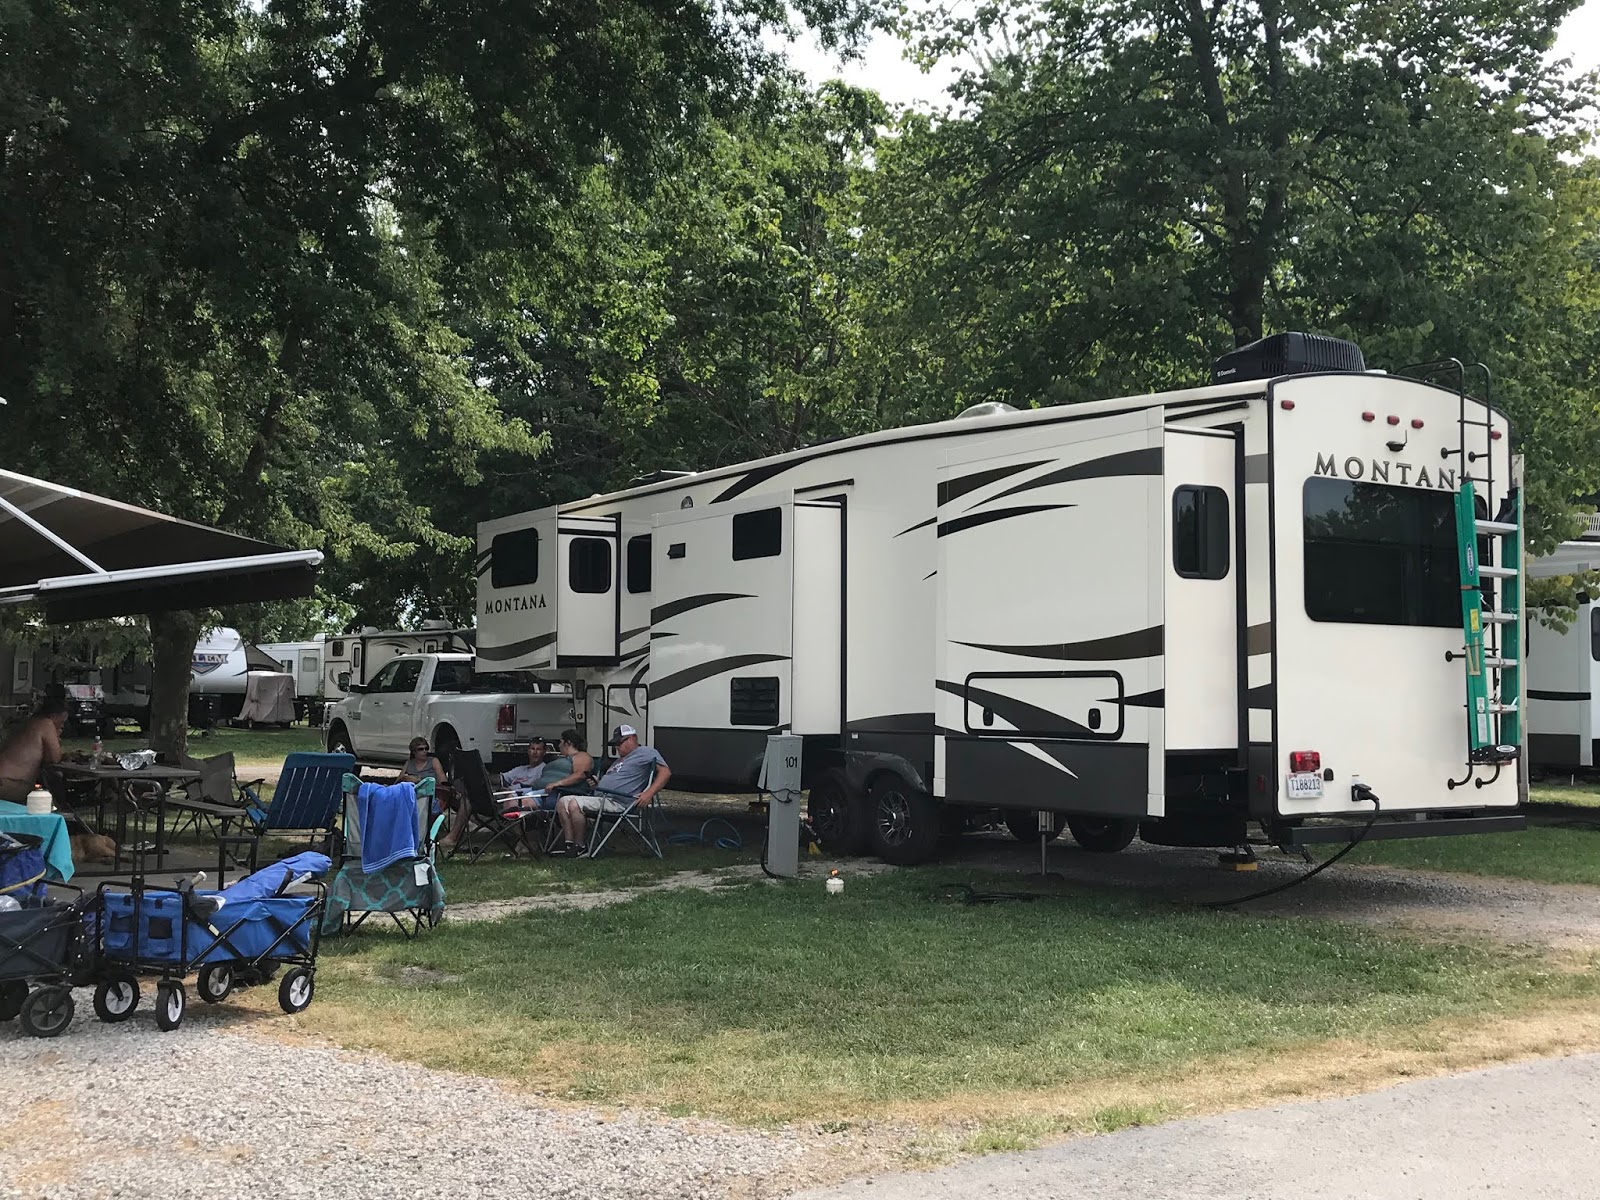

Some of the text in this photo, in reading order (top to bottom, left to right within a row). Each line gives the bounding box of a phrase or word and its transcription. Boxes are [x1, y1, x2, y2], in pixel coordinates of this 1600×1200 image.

[485, 593, 546, 614] MONTANA
[785, 756, 798, 768] 101
[1290, 778, 1321, 791] T188213
